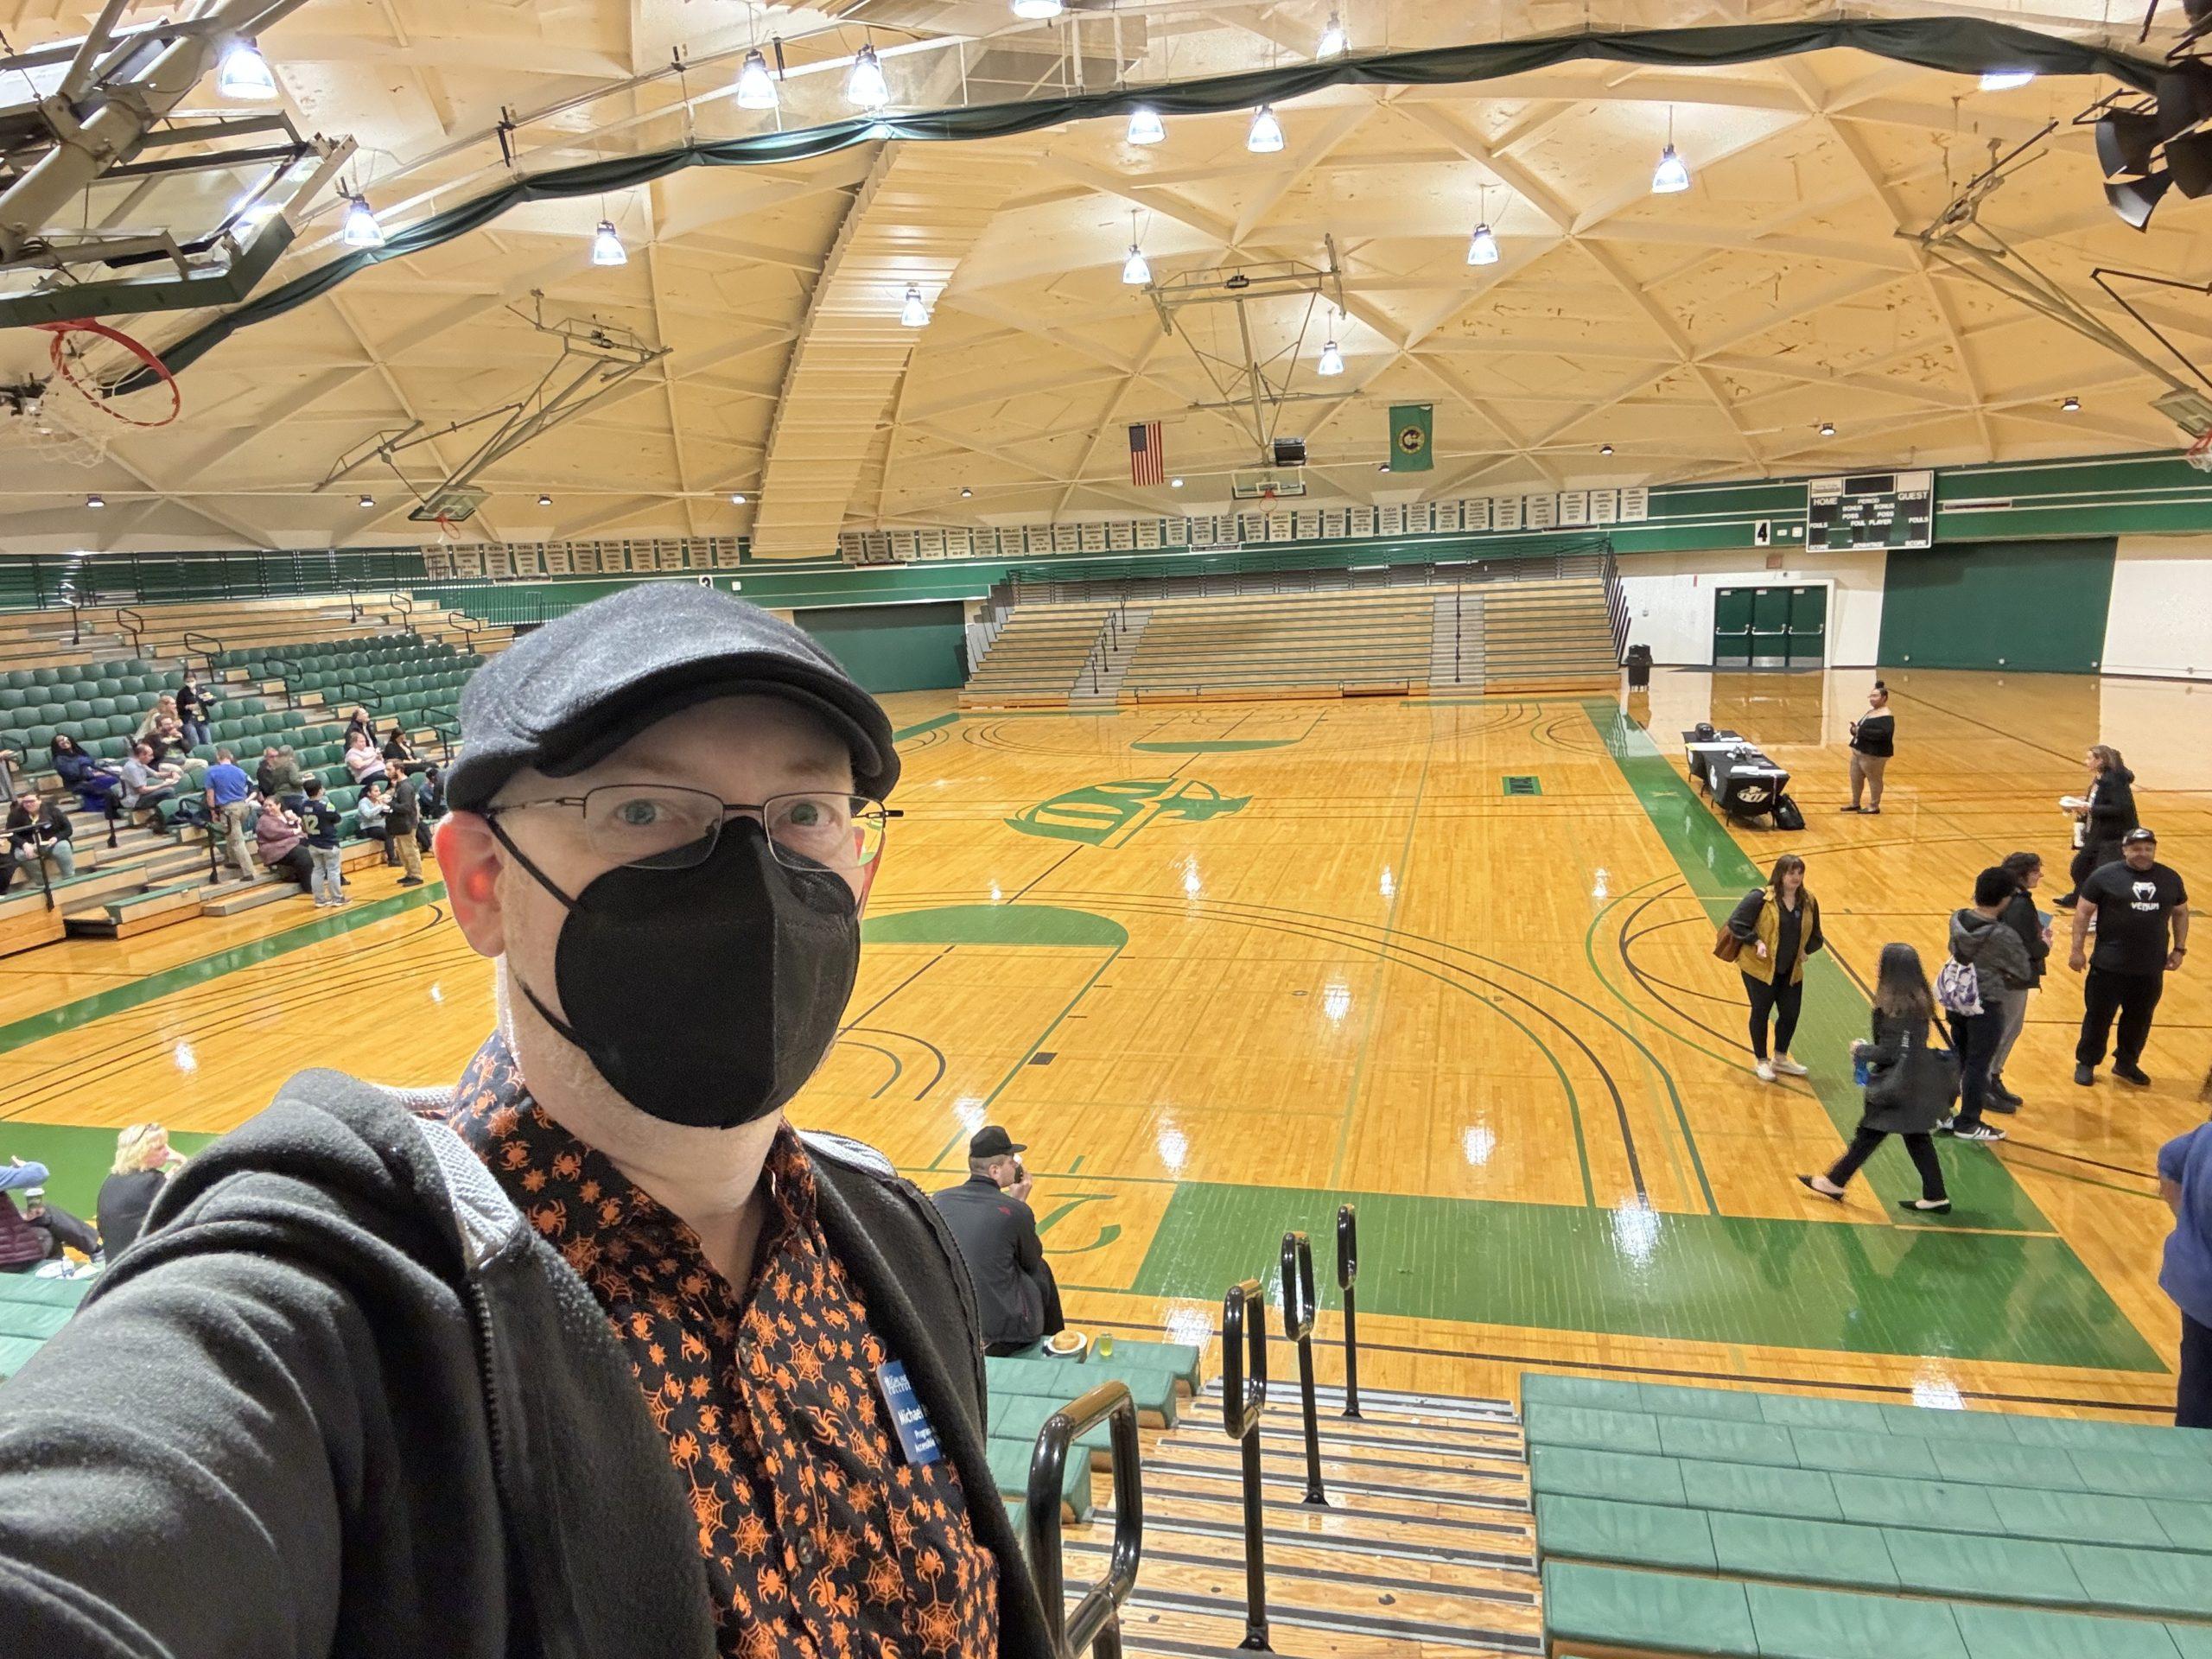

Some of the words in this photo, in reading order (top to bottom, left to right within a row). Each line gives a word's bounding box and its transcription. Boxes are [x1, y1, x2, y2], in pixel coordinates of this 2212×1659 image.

[1813, 497, 1838, 506] HOME
[1897, 491, 1929, 501] GUEST
[1758, 522, 1768, 542] 4
[2131, 901, 2159, 912] VENUM
[898, 1403, 925, 1427] Michael
